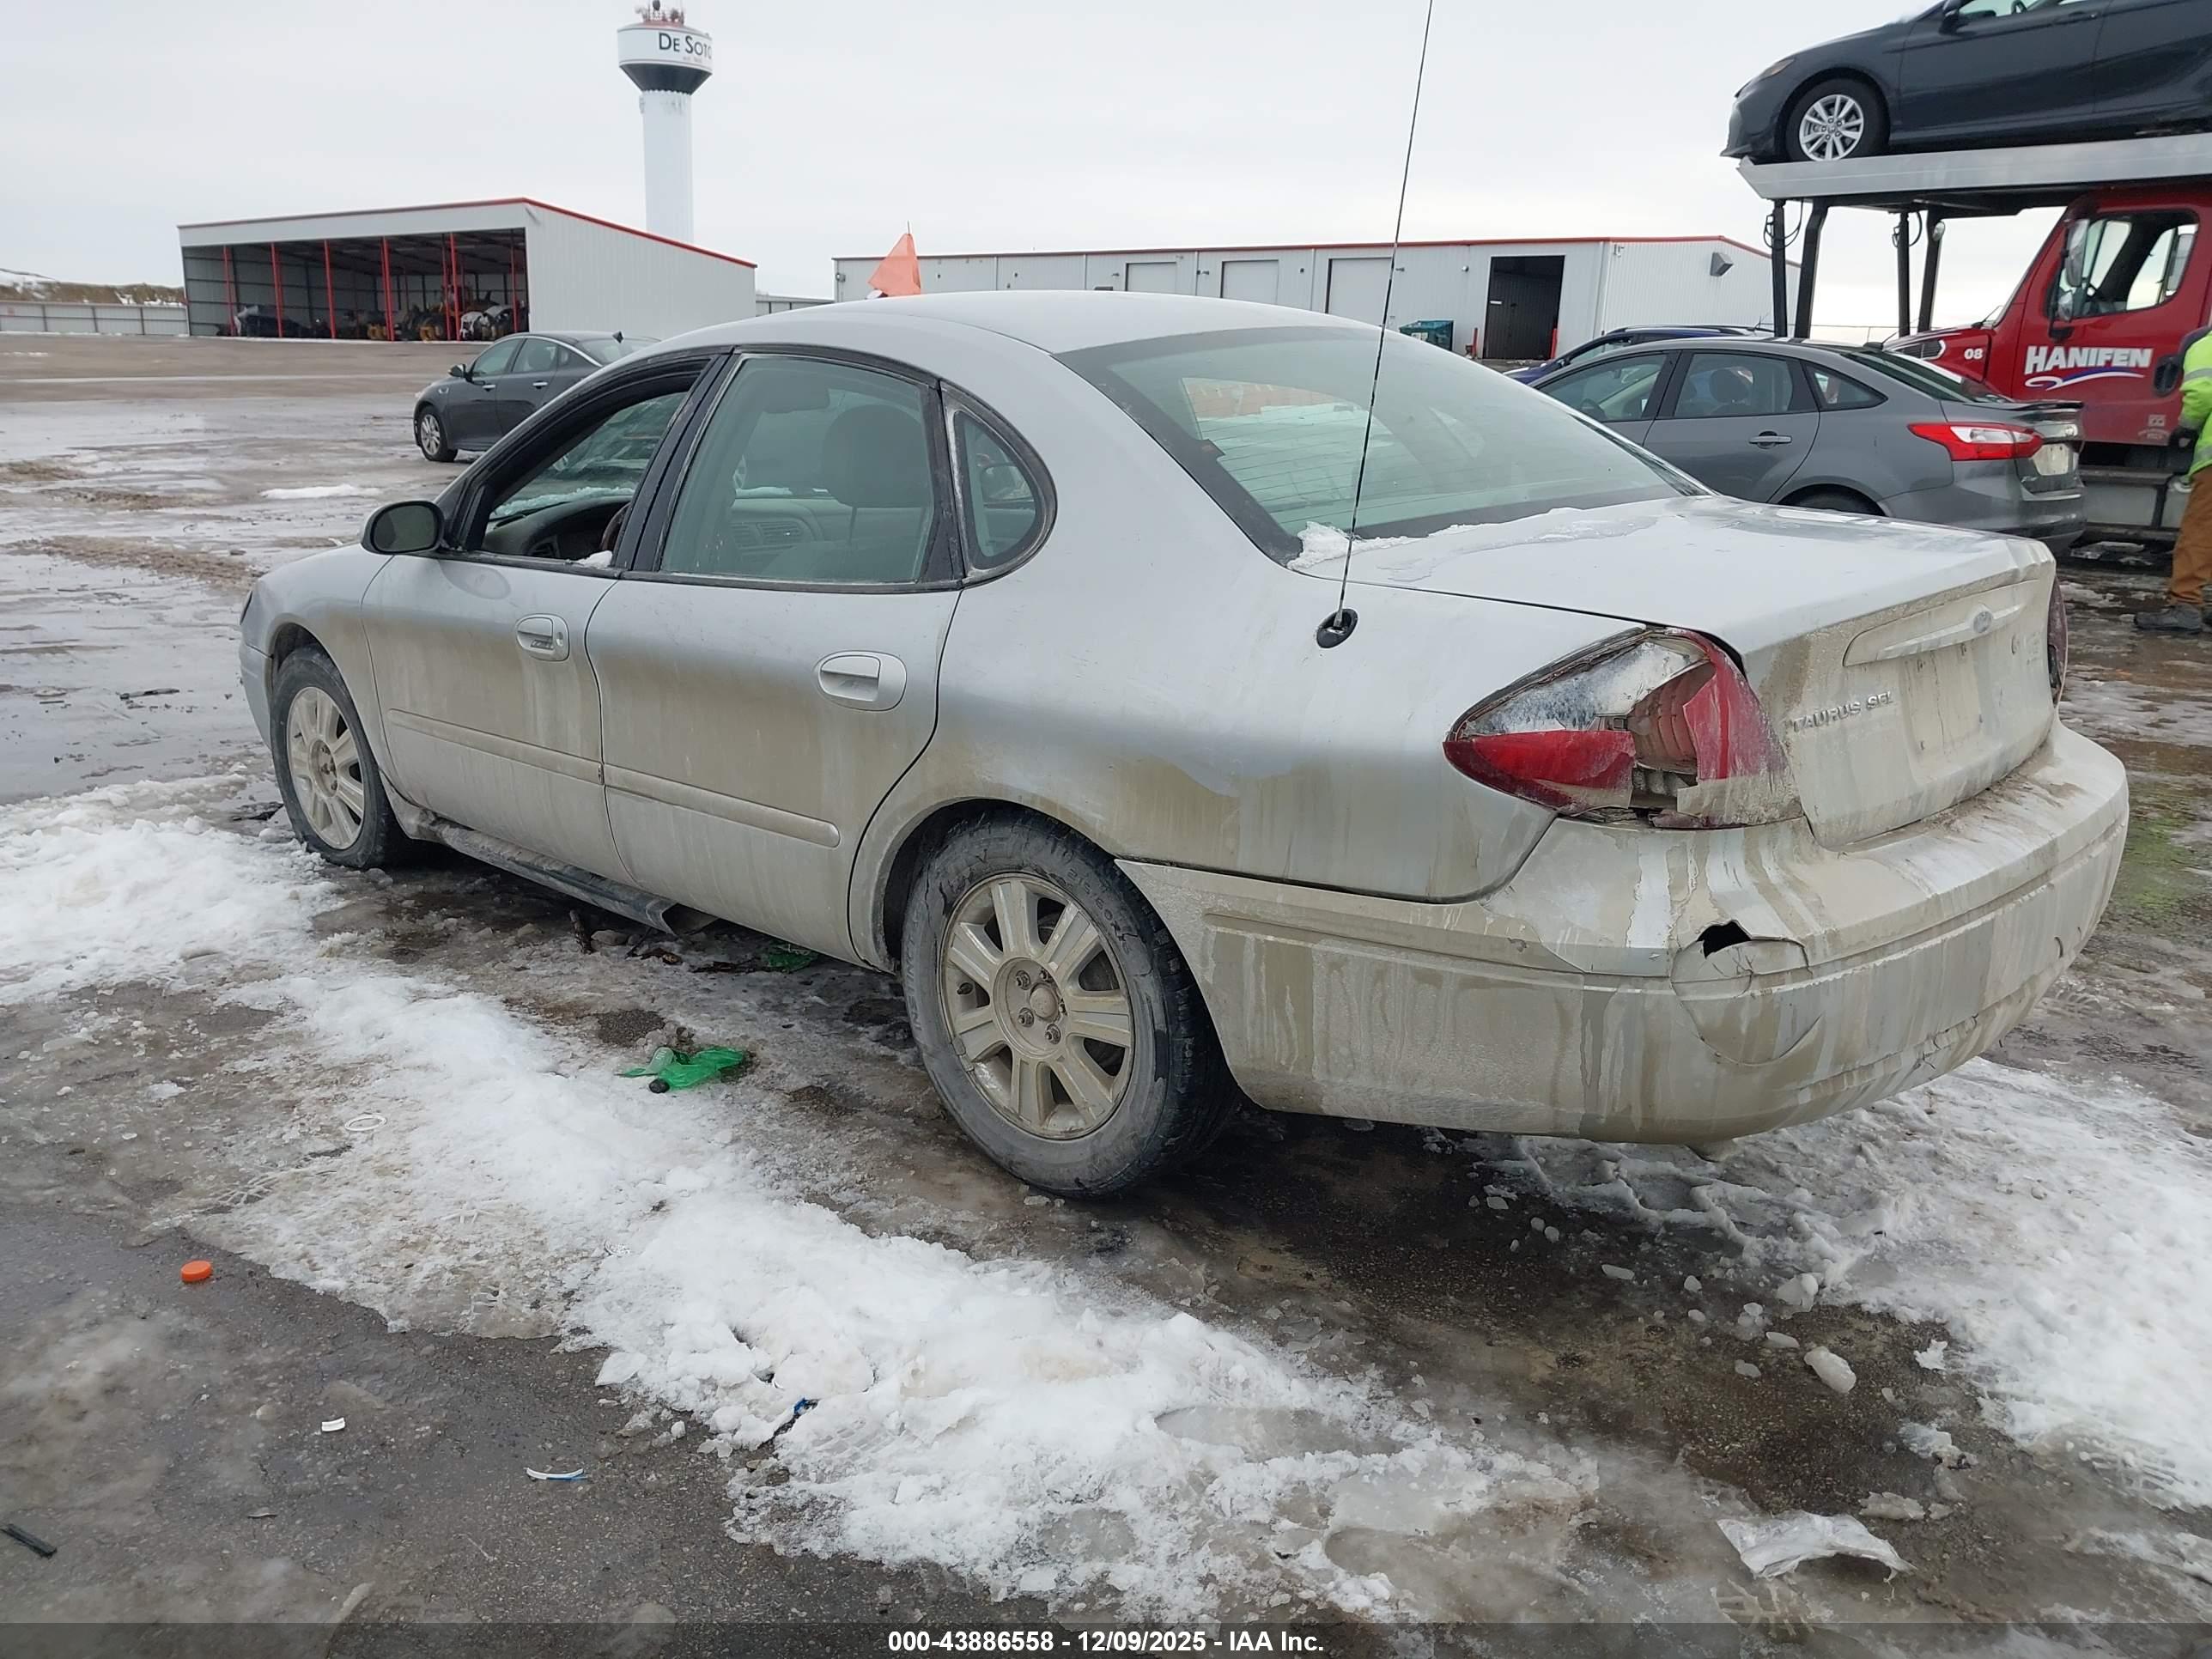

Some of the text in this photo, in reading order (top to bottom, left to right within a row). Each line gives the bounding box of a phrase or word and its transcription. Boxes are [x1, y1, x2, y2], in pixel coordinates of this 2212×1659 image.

[1964, 348, 1984, 360] 08
[2024, 345, 2154, 374] HANIFEN
[1792, 701, 1861, 732] TAURUS
